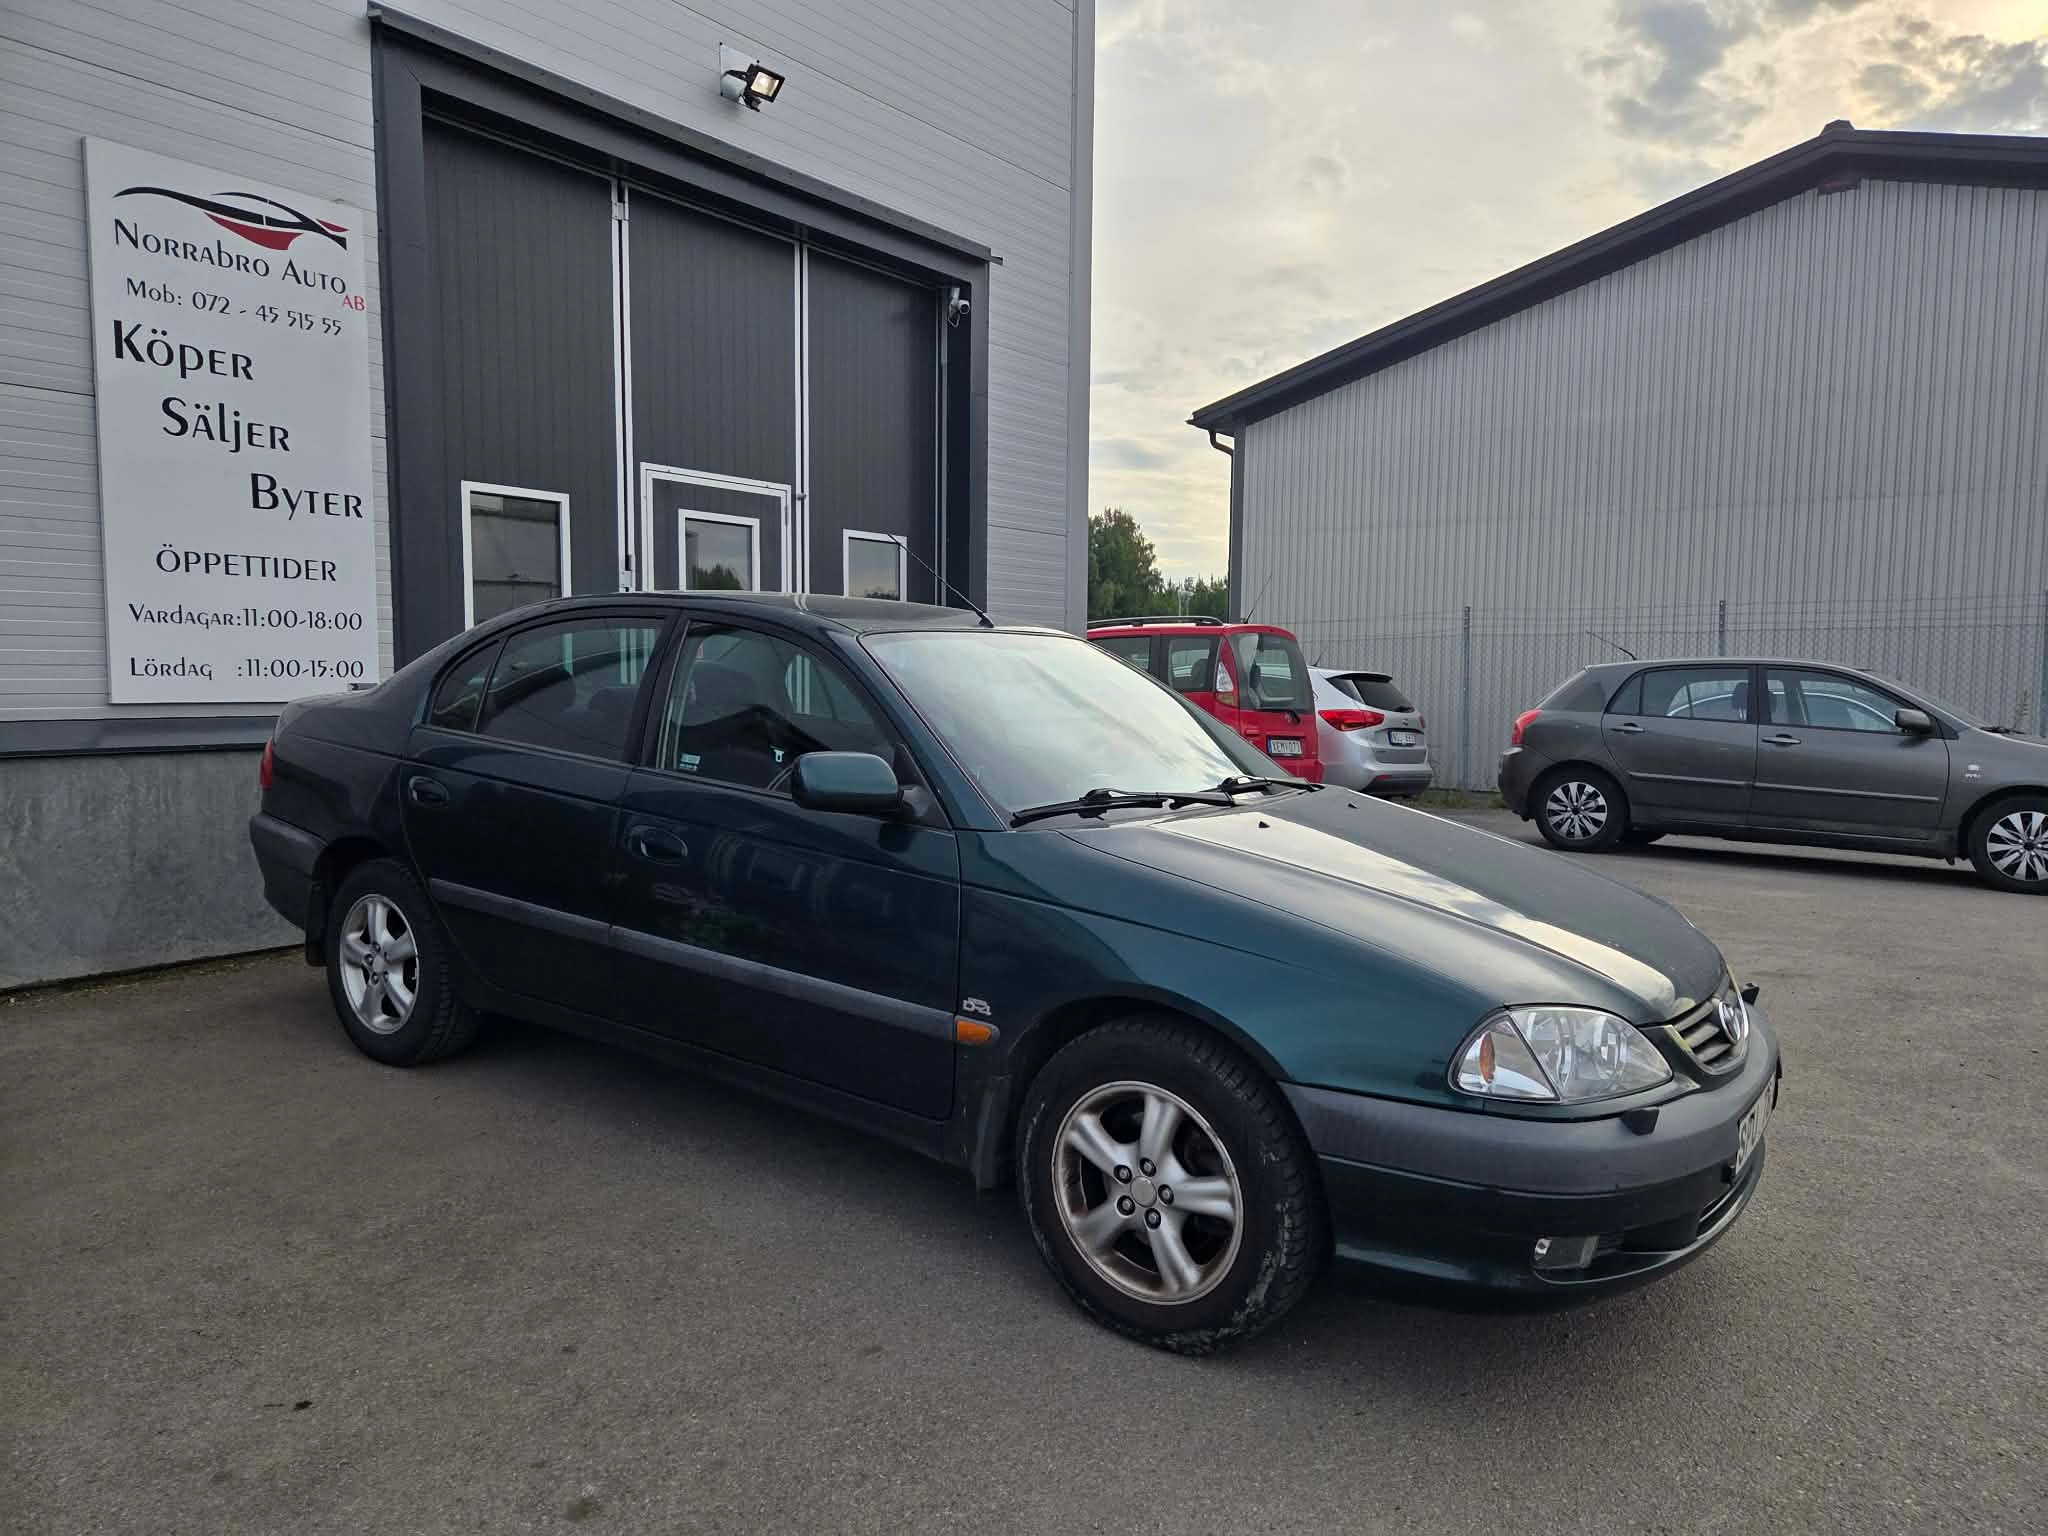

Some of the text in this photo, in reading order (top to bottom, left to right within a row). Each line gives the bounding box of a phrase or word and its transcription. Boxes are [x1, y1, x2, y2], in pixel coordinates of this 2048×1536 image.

[281, 259, 346, 294] Auto
[127, 277, 182, 305] Mob:
[192, 291, 231, 315] 072
[255, 305, 280, 323] 45
[288, 310, 315, 331] 515
[322, 317, 342, 336] 55
[342, 295, 366, 311] AB
[113, 320, 254, 380] Köper
[162, 396, 290, 453] Säljer
[250, 472, 363, 520] Byter
[156, 543, 337, 582] ÖPPETTIDER
[130, 656, 213, 680] Lördag
